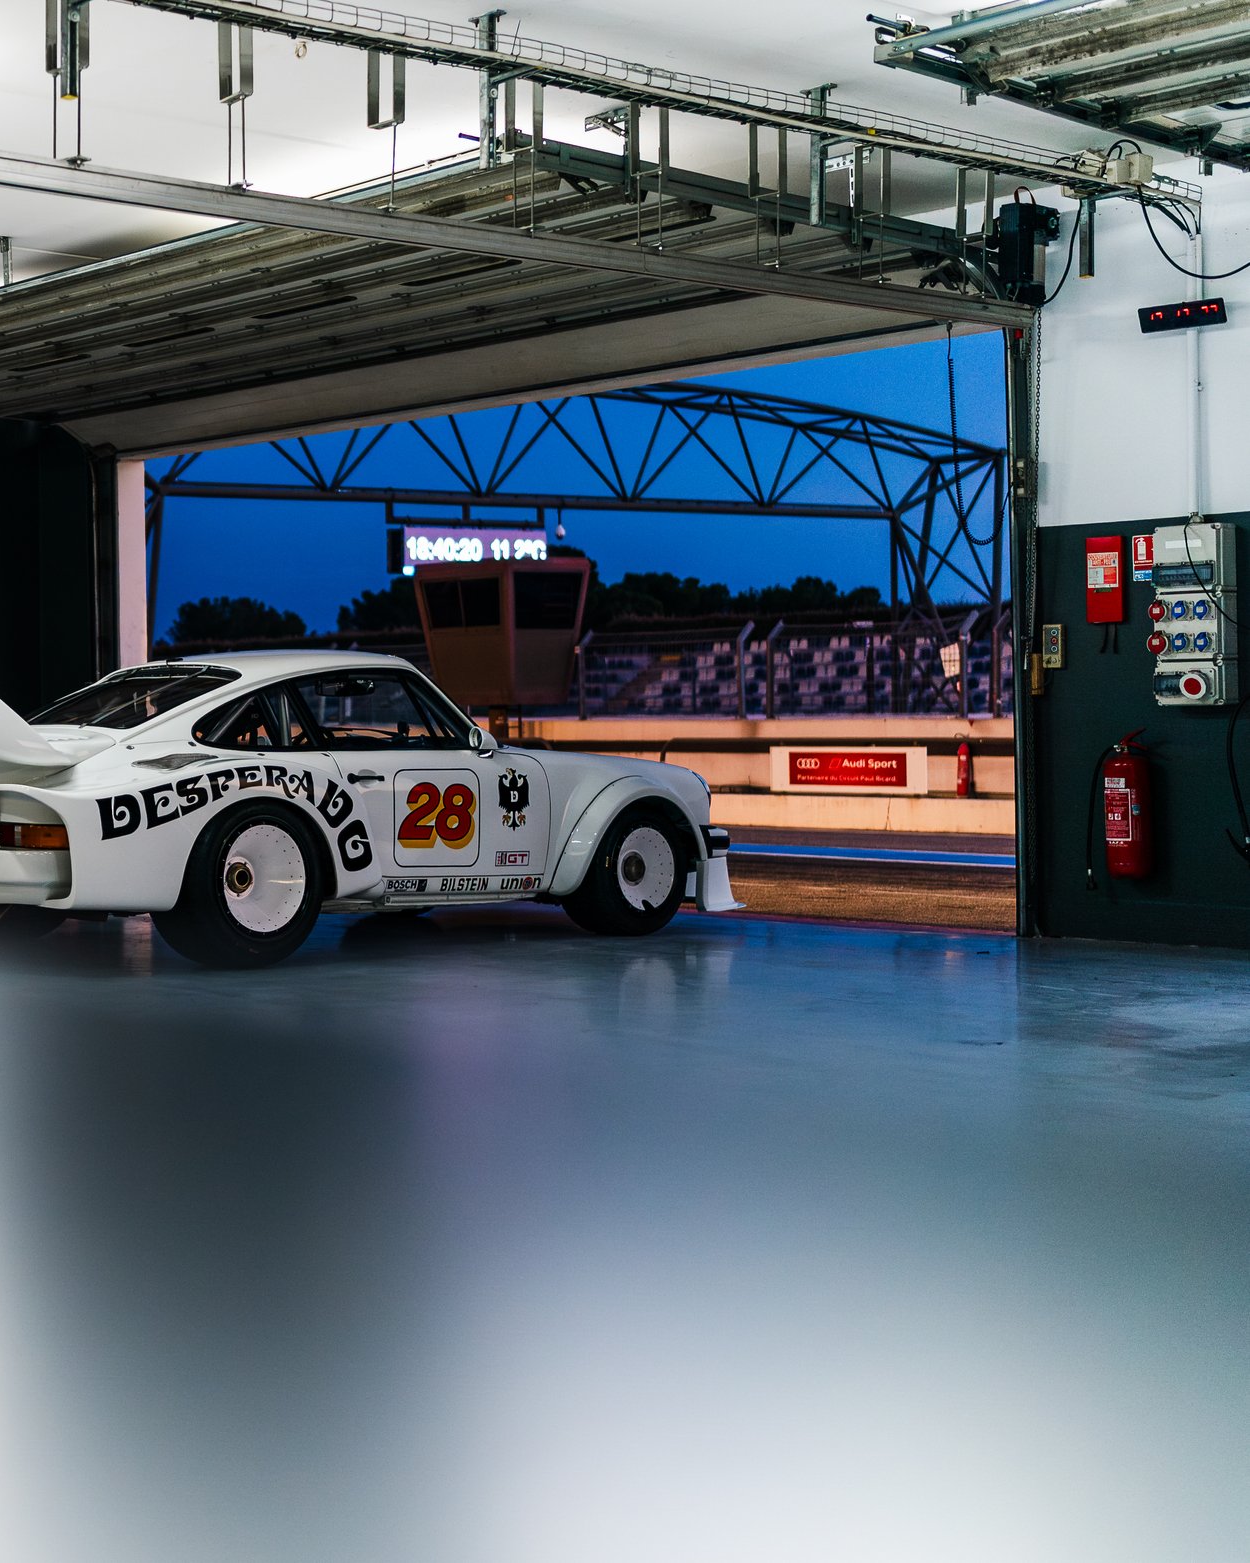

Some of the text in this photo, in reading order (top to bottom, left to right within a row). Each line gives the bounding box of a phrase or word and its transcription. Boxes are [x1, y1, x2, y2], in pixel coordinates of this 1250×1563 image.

[842, 758, 898, 770] Audi Sport
[95, 765, 373, 872] DESPERADO
[397, 781, 477, 850] 28
[508, 853, 528, 864] GT
[387, 880, 418, 890] BOSCH
[439, 877, 489, 892] BILSTEIN
